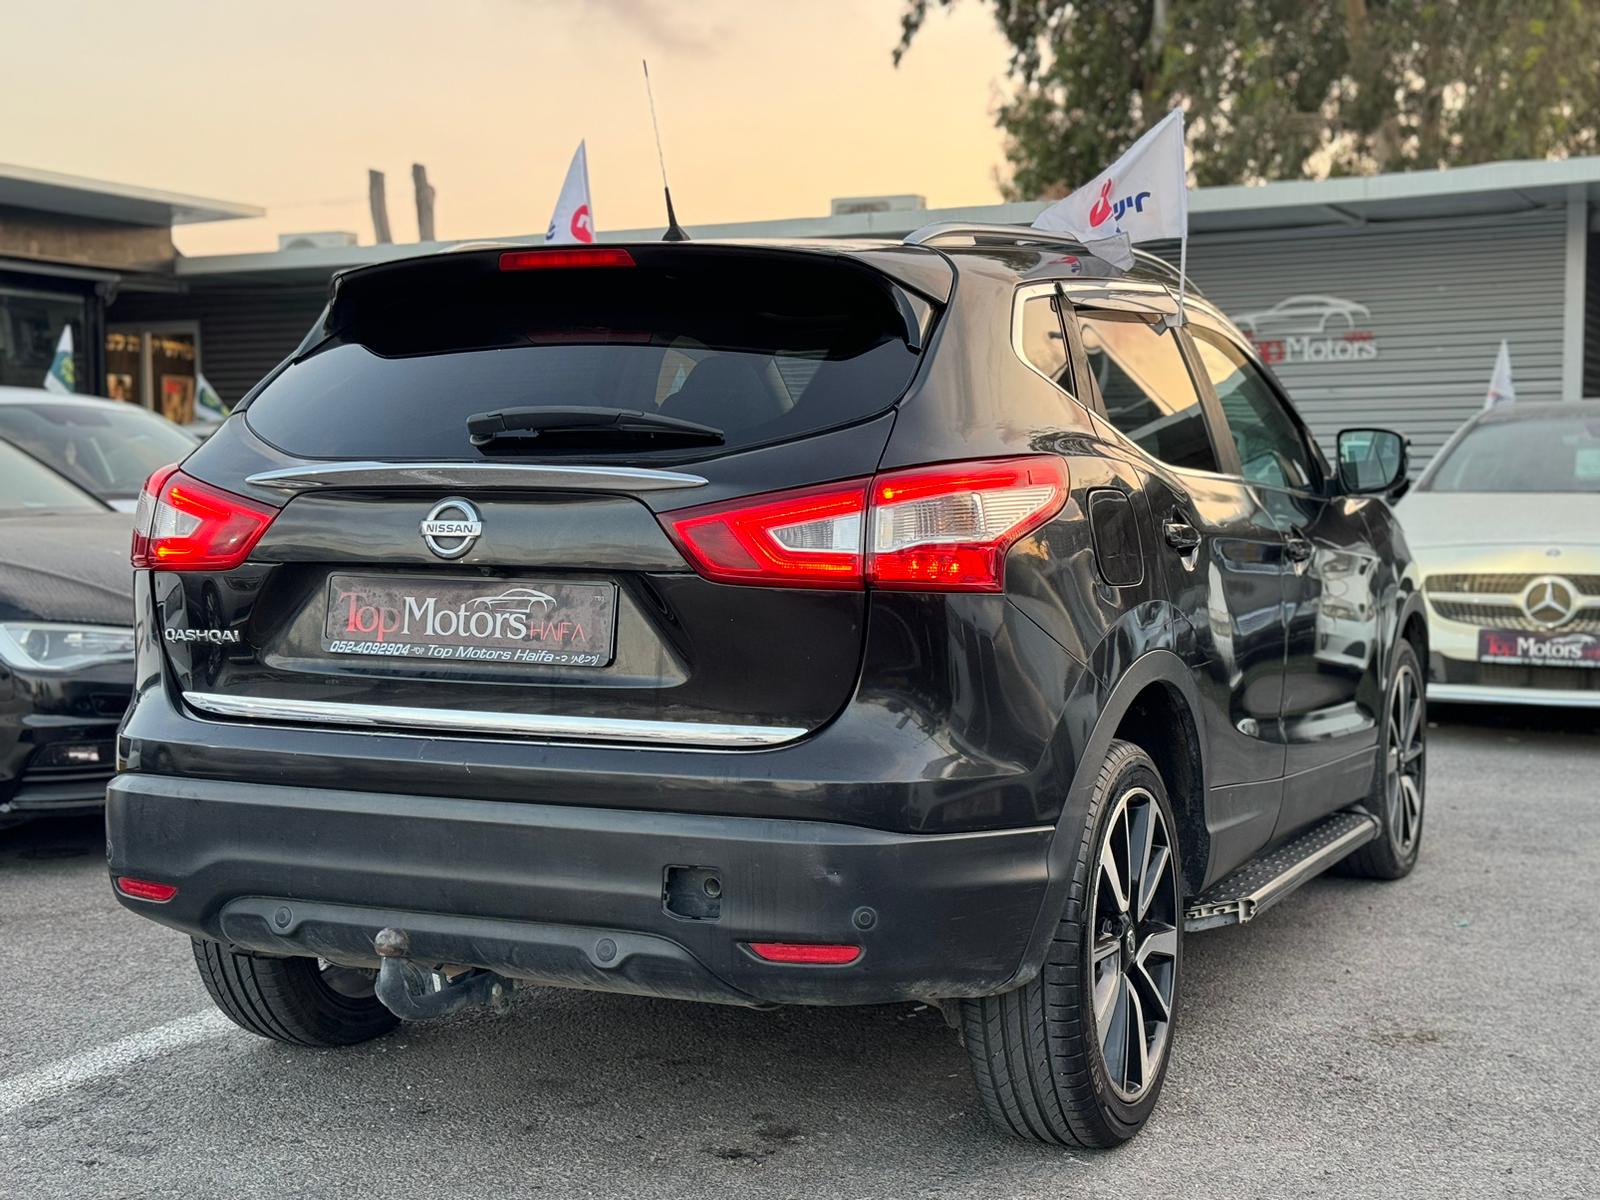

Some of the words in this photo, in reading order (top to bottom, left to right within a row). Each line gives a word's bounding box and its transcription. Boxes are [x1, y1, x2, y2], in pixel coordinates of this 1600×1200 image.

[1286, 337, 1378, 361] Motors
[426, 524, 474, 533] NISSAN
[338, 591, 400, 642] Top
[401, 597, 527, 638] Motors
[530, 621, 586, 642] HAIFA
[164, 628, 240, 645] QASHQAI
[329, 640, 411, 656] 052-4092904
[427, 644, 453, 659] Top
[455, 646, 512, 660] Motors
[1517, 636, 1583, 658] Motors
